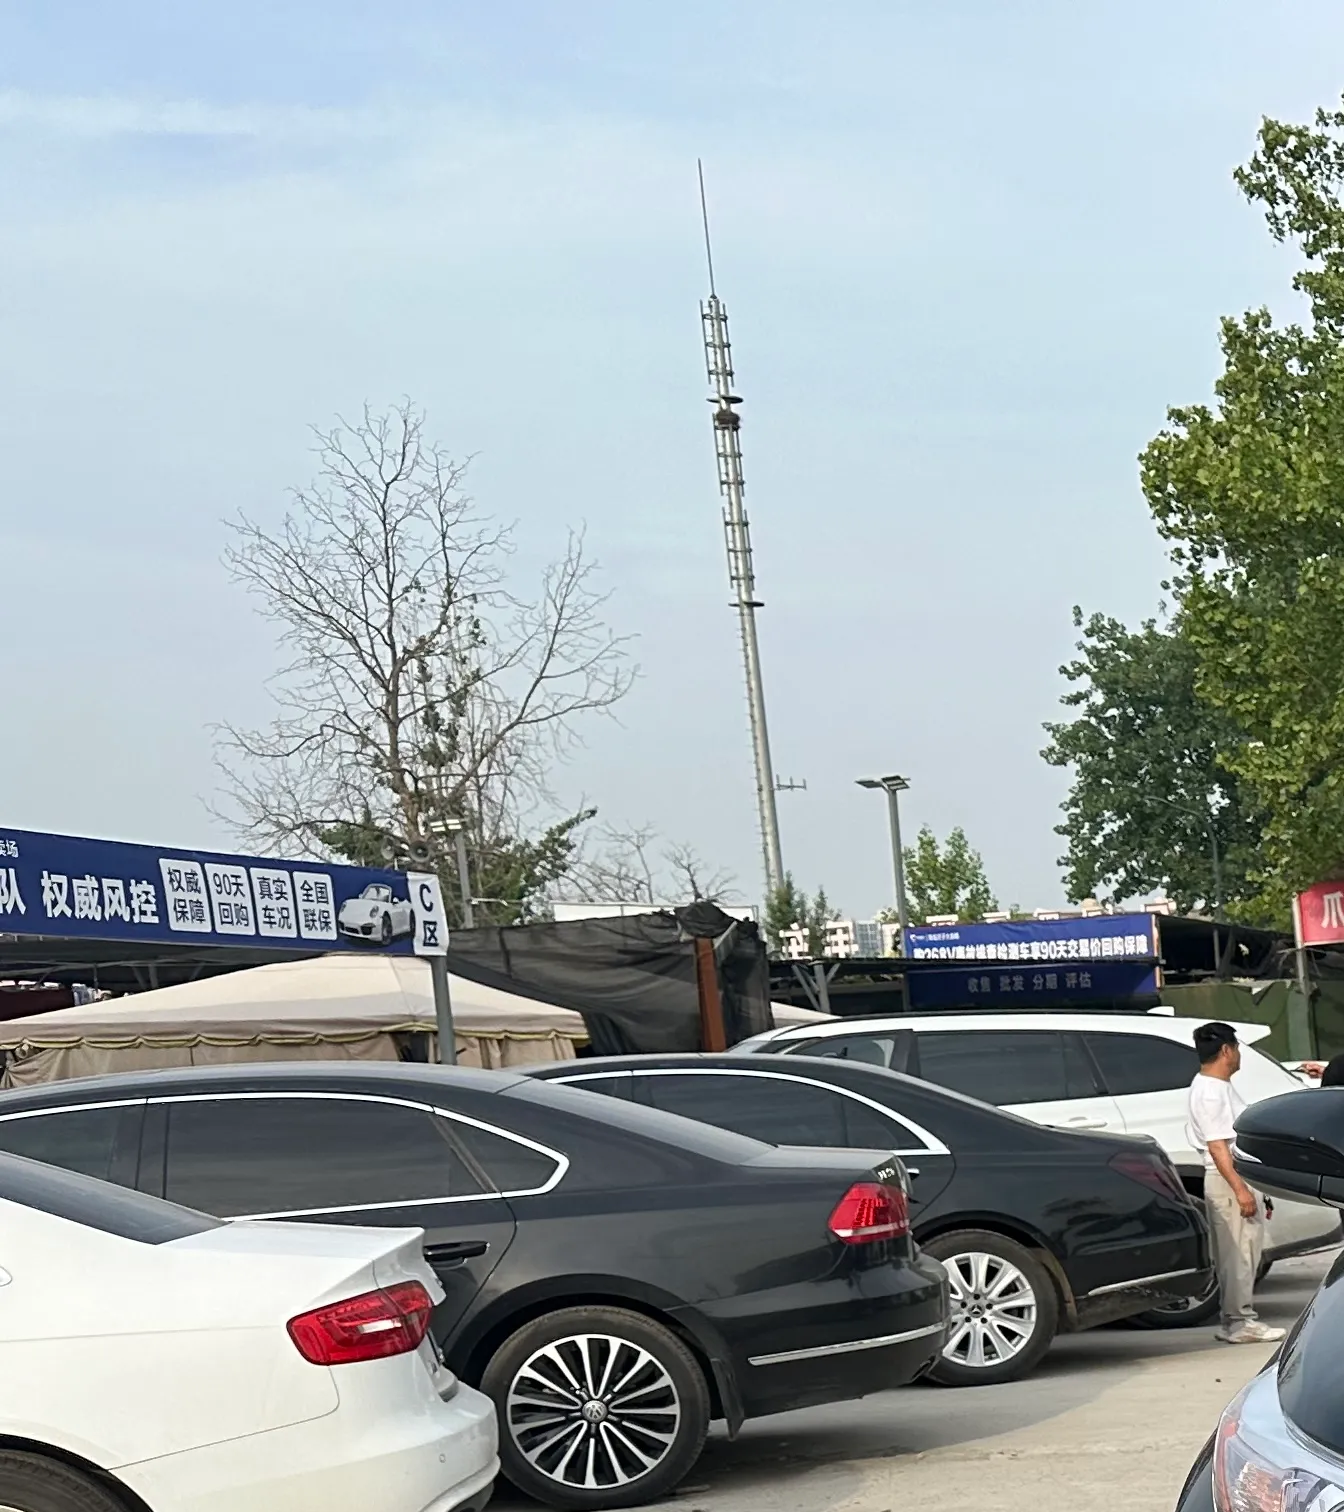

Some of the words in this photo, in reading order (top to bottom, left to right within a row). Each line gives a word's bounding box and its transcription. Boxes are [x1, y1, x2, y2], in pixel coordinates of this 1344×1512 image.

[167, 867, 201, 895] 权威
[213, 873, 246, 898] 90天
[257, 876, 288, 901] 真实
[300, 880, 330, 905] 全国
[41, 870, 160, 924] 权威风控
[173, 898, 206, 925] 保障
[218, 902, 249, 928] 回购
[262, 906, 292, 930] 车况
[303, 908, 333, 933] 联保
